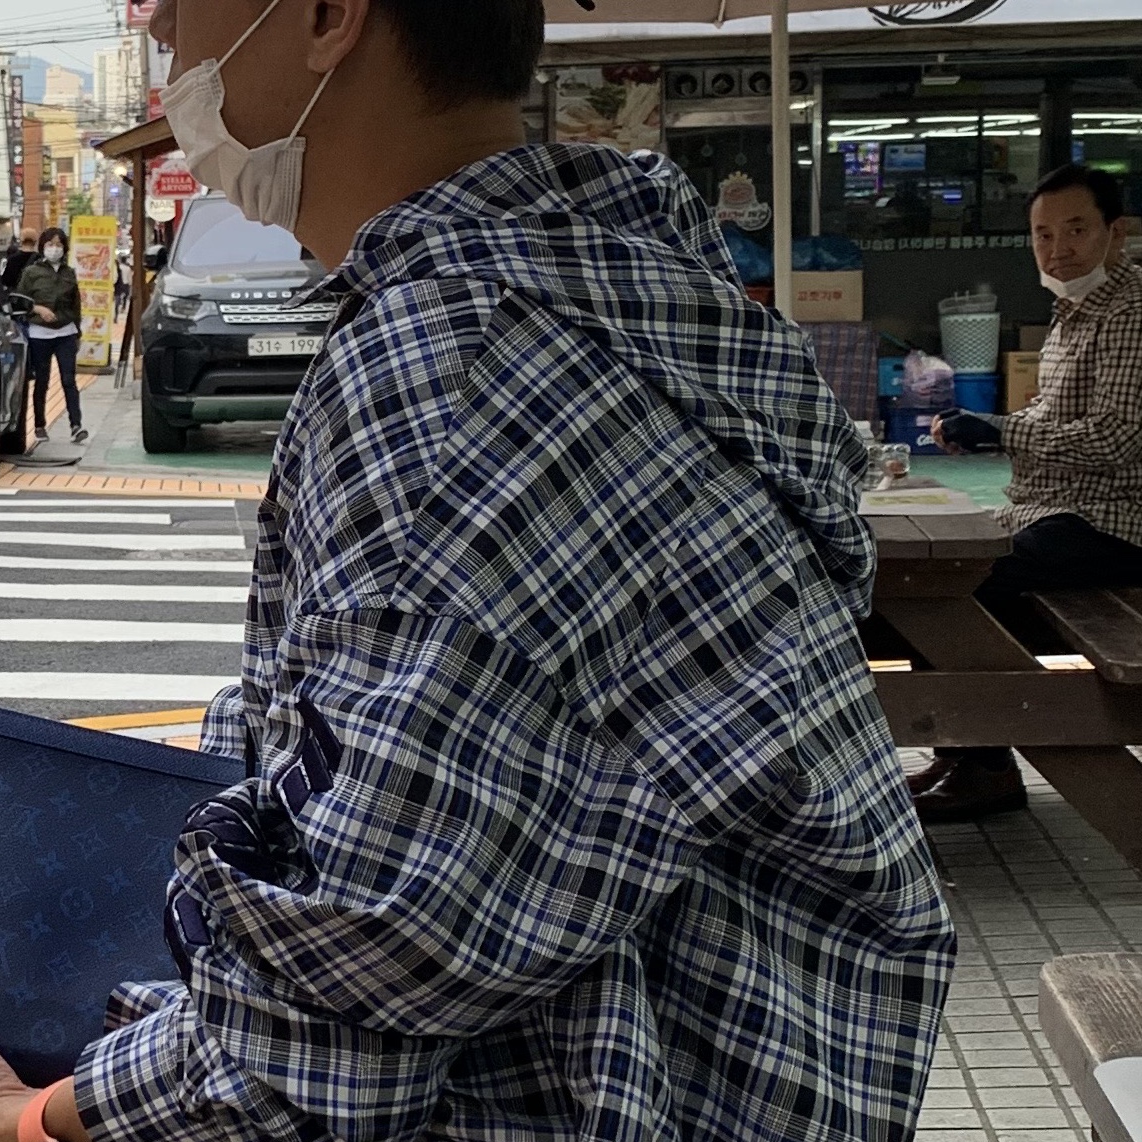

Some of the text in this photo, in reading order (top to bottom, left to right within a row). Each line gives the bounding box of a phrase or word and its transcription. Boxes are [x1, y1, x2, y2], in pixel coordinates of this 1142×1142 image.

[161, 176, 193, 184] STELLA
[161, 184, 193, 192] ARTOIS
[230, 290, 292, 299] DISCO
